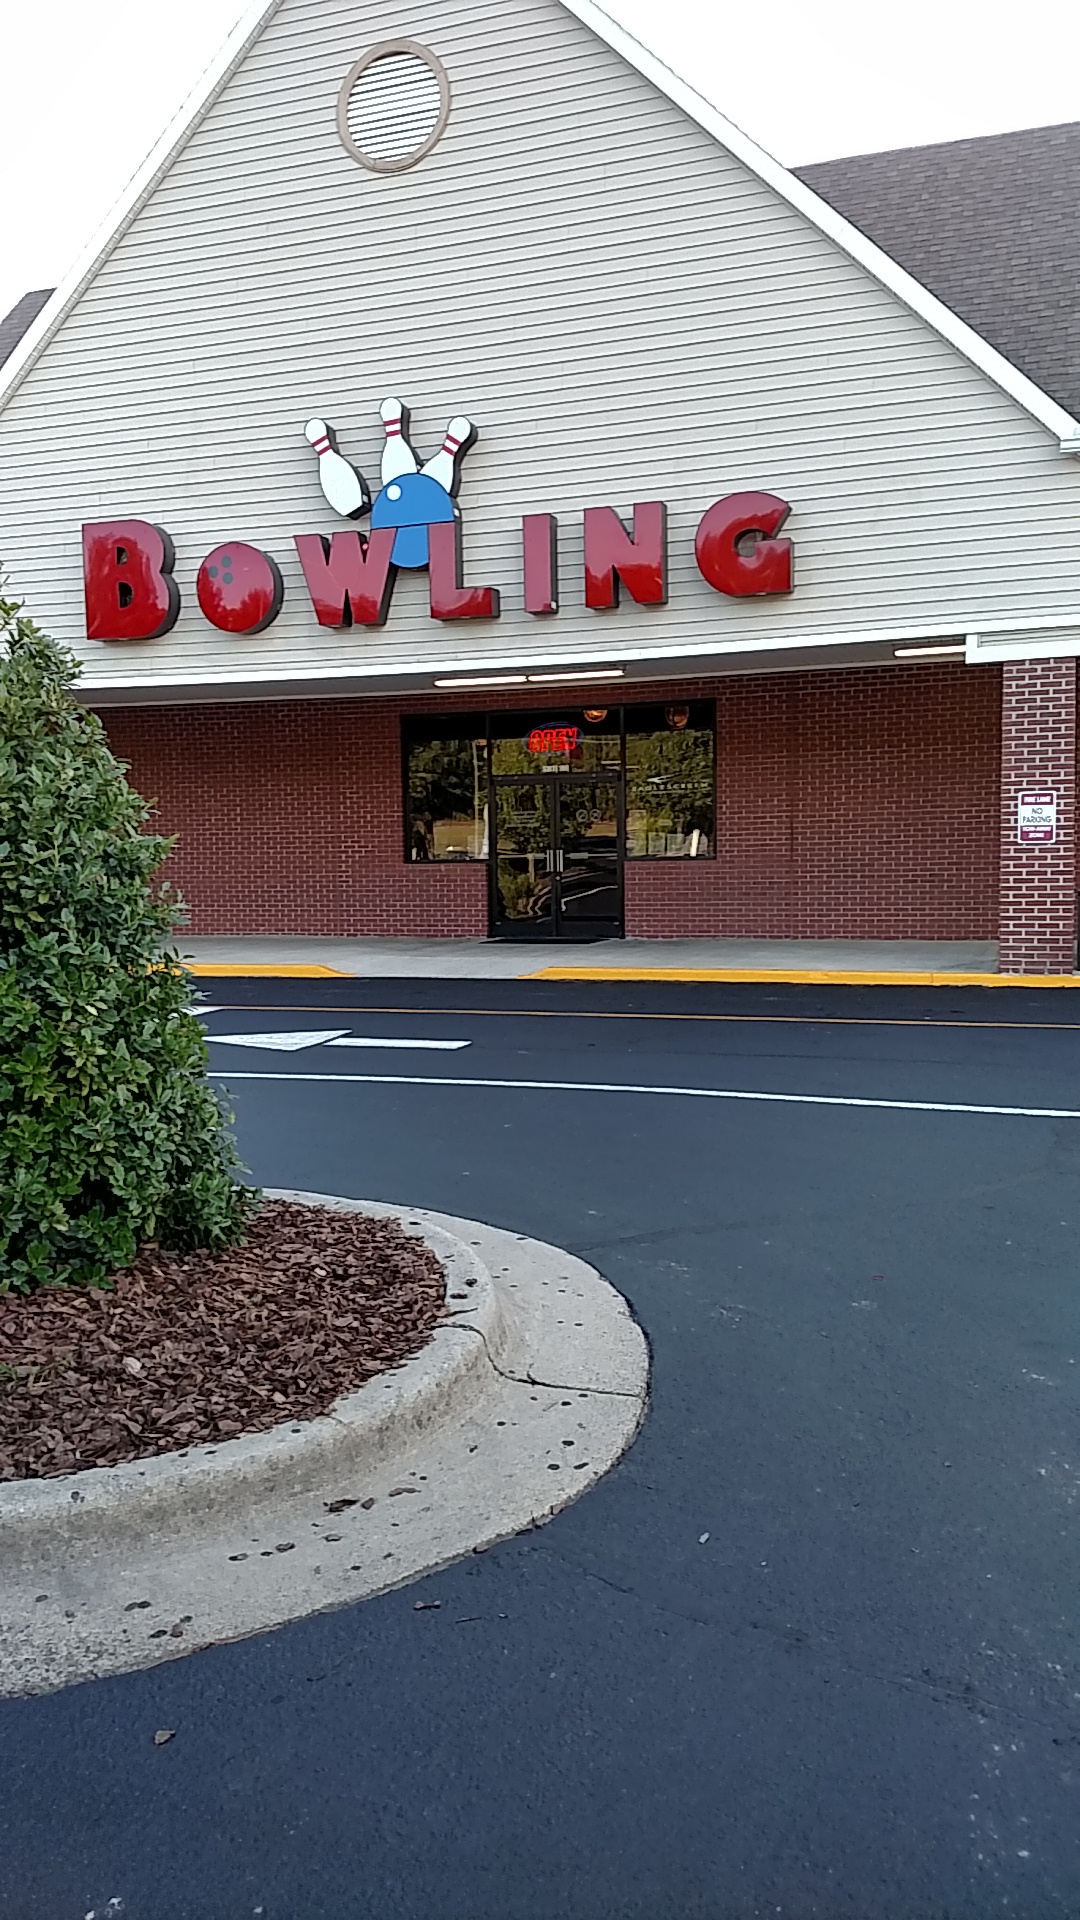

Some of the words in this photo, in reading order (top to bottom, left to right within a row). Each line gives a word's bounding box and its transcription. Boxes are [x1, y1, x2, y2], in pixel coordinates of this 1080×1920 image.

[81, 490, 796, 641] BOWLING
[528, 727, 578, 753] OPEN
[1022, 815, 1052, 823] PARKING
[1031, 807, 1043, 815] NO
